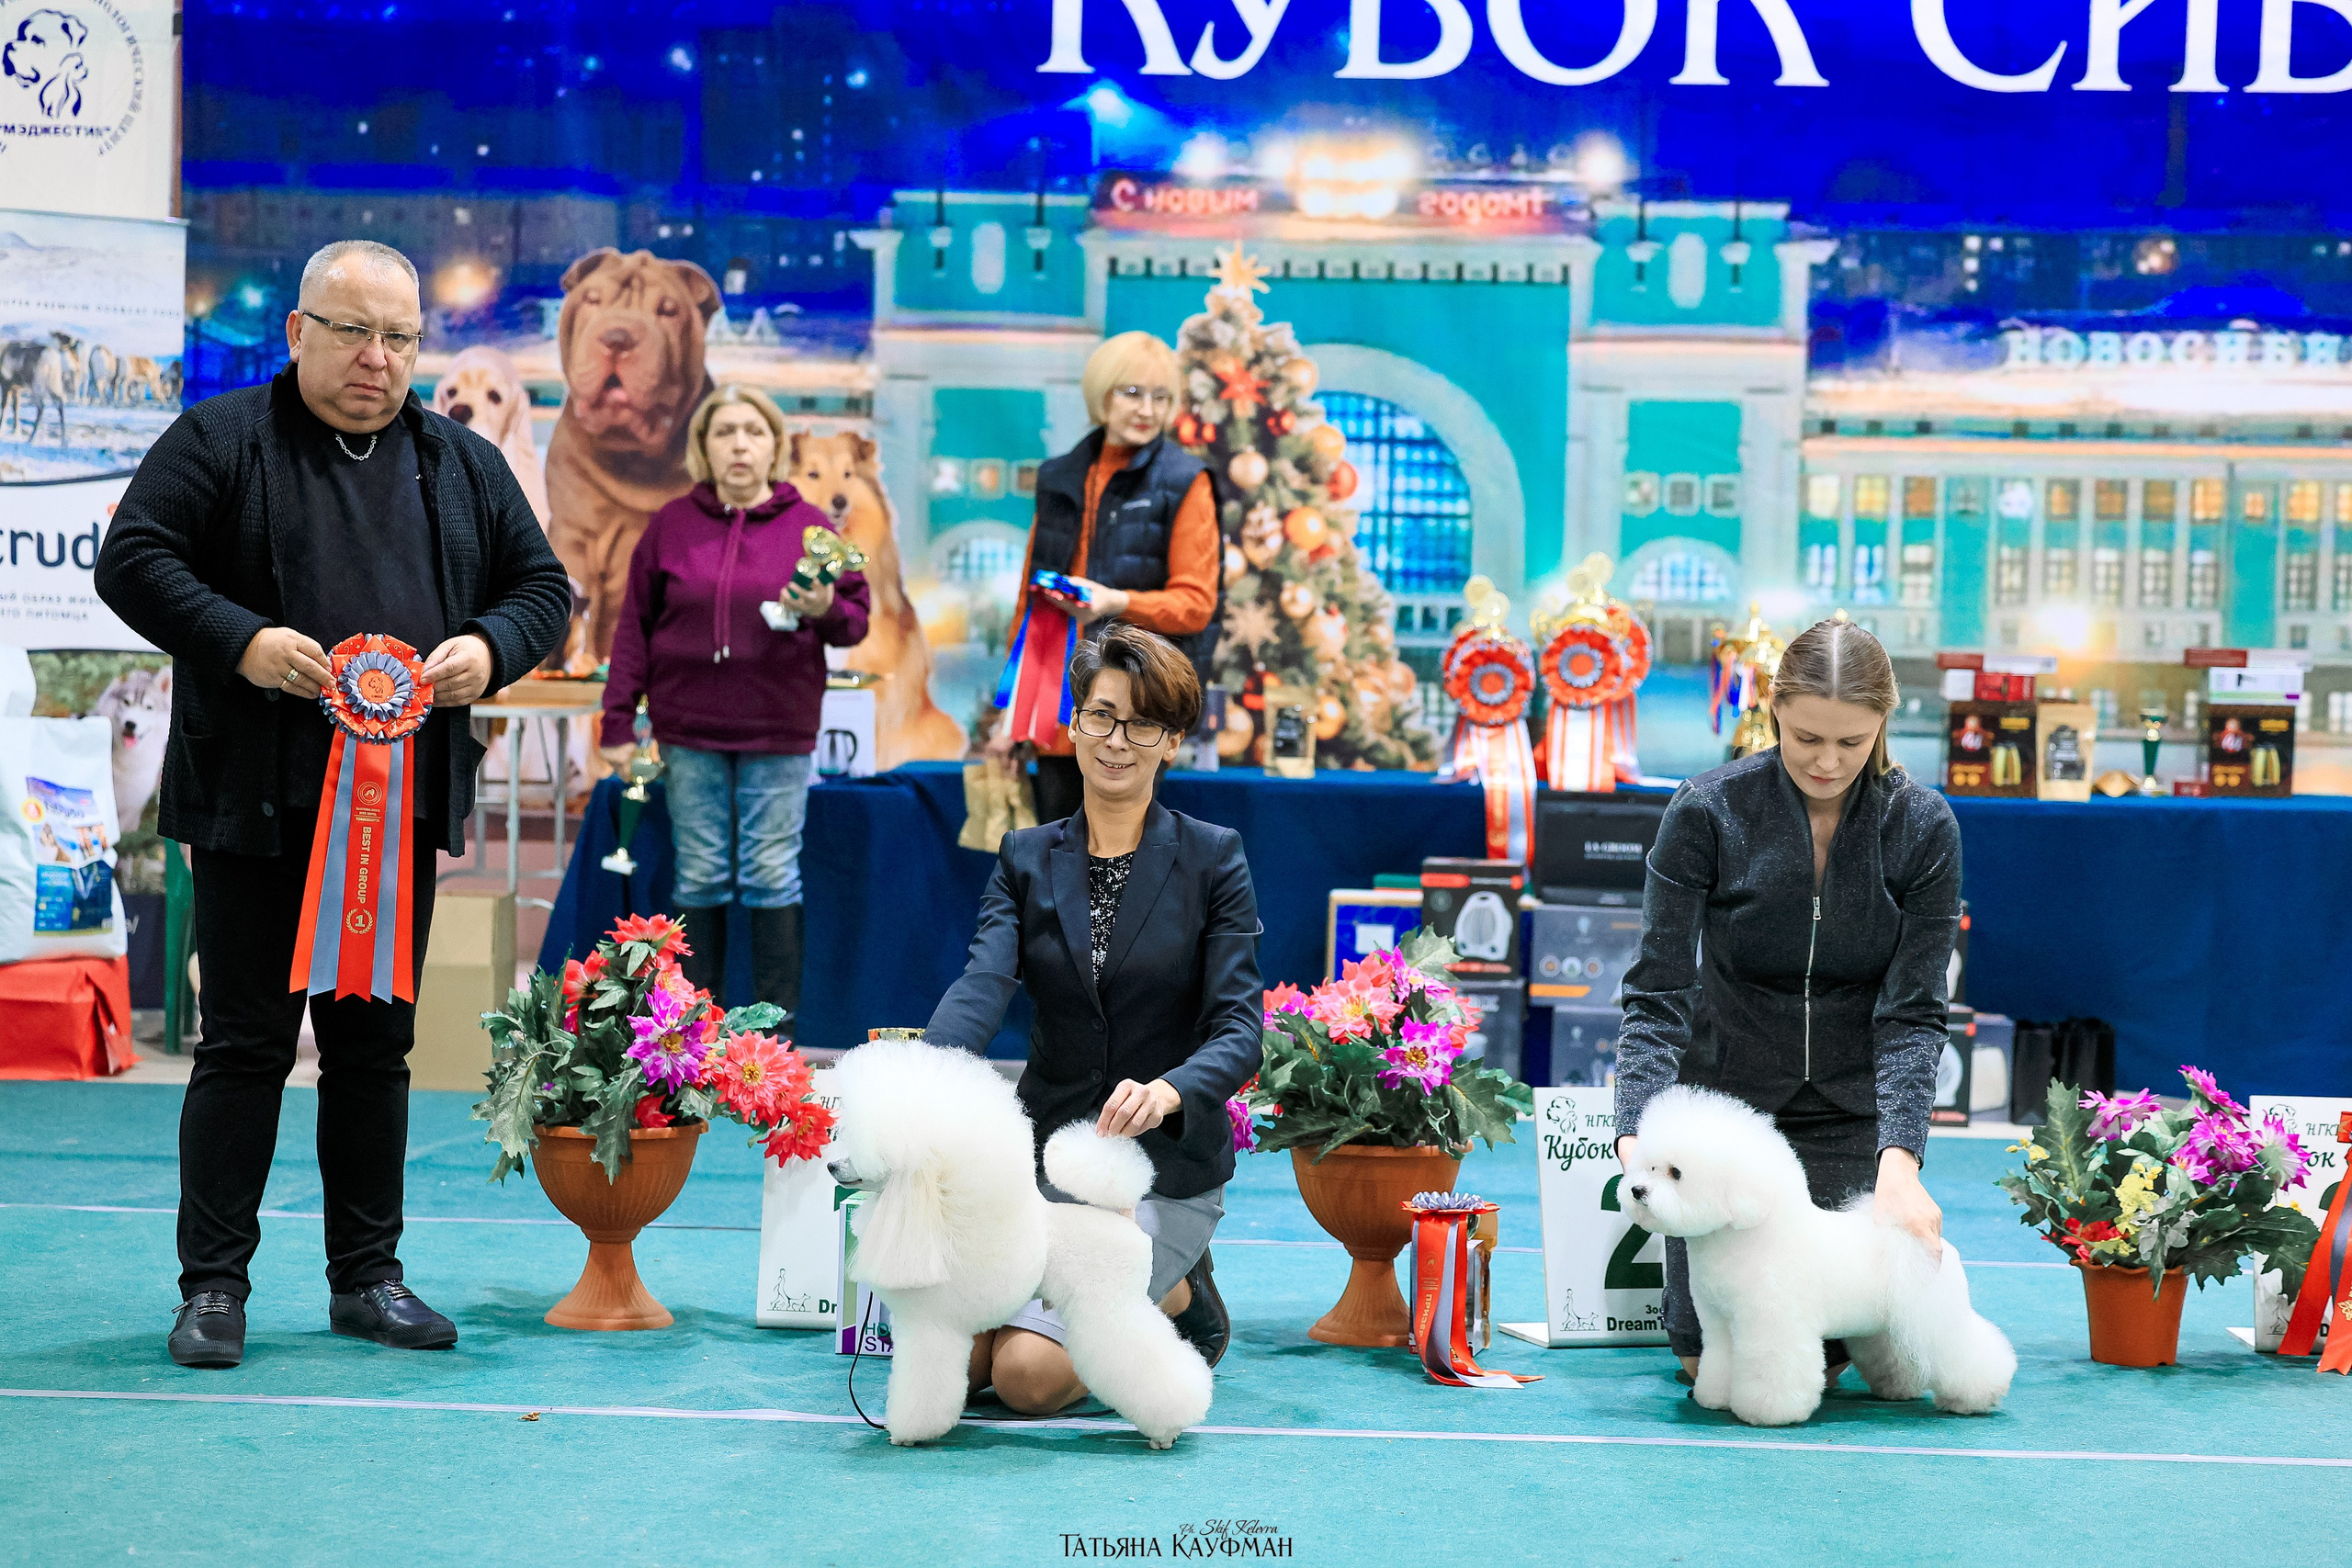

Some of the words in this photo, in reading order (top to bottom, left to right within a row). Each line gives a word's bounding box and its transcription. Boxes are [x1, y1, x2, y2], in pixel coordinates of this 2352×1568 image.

[361, 826, 372, 852] BEST
[360, 853, 370, 865] IN
[356, 867, 368, 905] GROUP
[355, 914, 366, 928] 1
[1544, 1134, 1614, 1171] Кубок
[1600, 1173, 1664, 1290] 2
